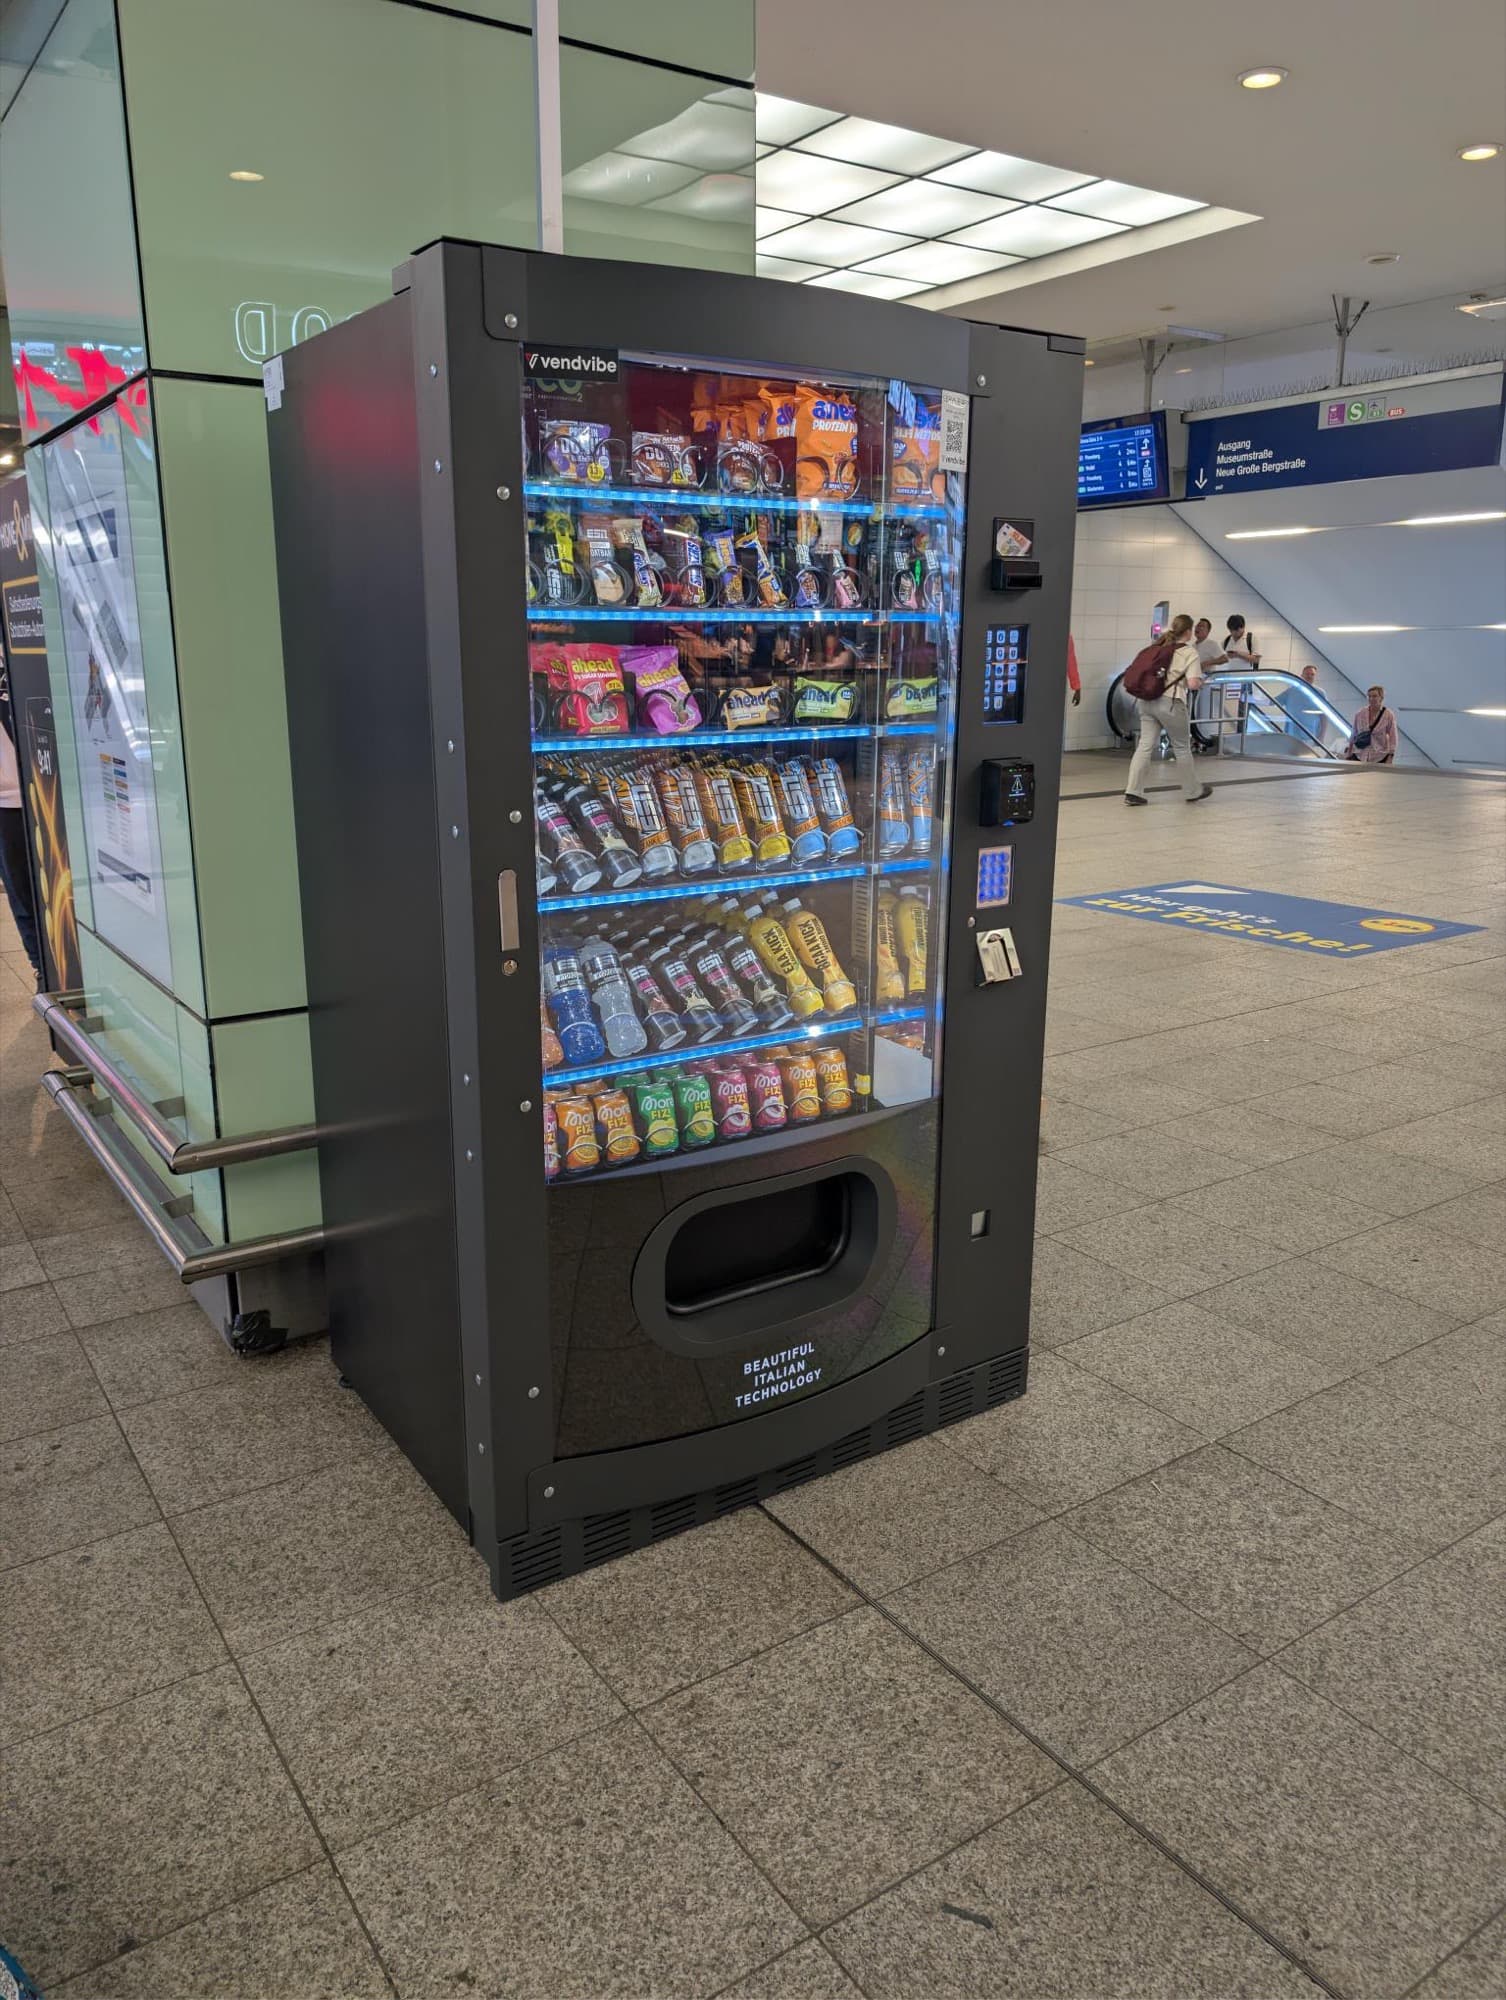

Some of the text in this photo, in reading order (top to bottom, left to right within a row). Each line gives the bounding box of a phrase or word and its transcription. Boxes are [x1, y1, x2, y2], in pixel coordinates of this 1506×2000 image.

[540, 353, 617, 373] vendvibe
[1216, 449, 1274, 464] Museumstraße
[1217, 440, 1251, 452] Ausgang
[1215, 458, 1306, 477] Neue Große Bergstraße
[571, 658, 615, 673] ahead
[1119, 893, 1277, 924] Hier geht's
[798, 919, 817, 946] KICK
[1083, 898, 1166, 913] zur
[1160, 911, 1375, 952] Frische!
[762, 928, 784, 955] KICK
[718, 1080, 748, 1097] Mor
[743, 1342, 815, 1376] BEAUTIFUL
[754, 1359, 805, 1387] ITALIAN
[735, 1367, 822, 1408] TECHNOLOGY
